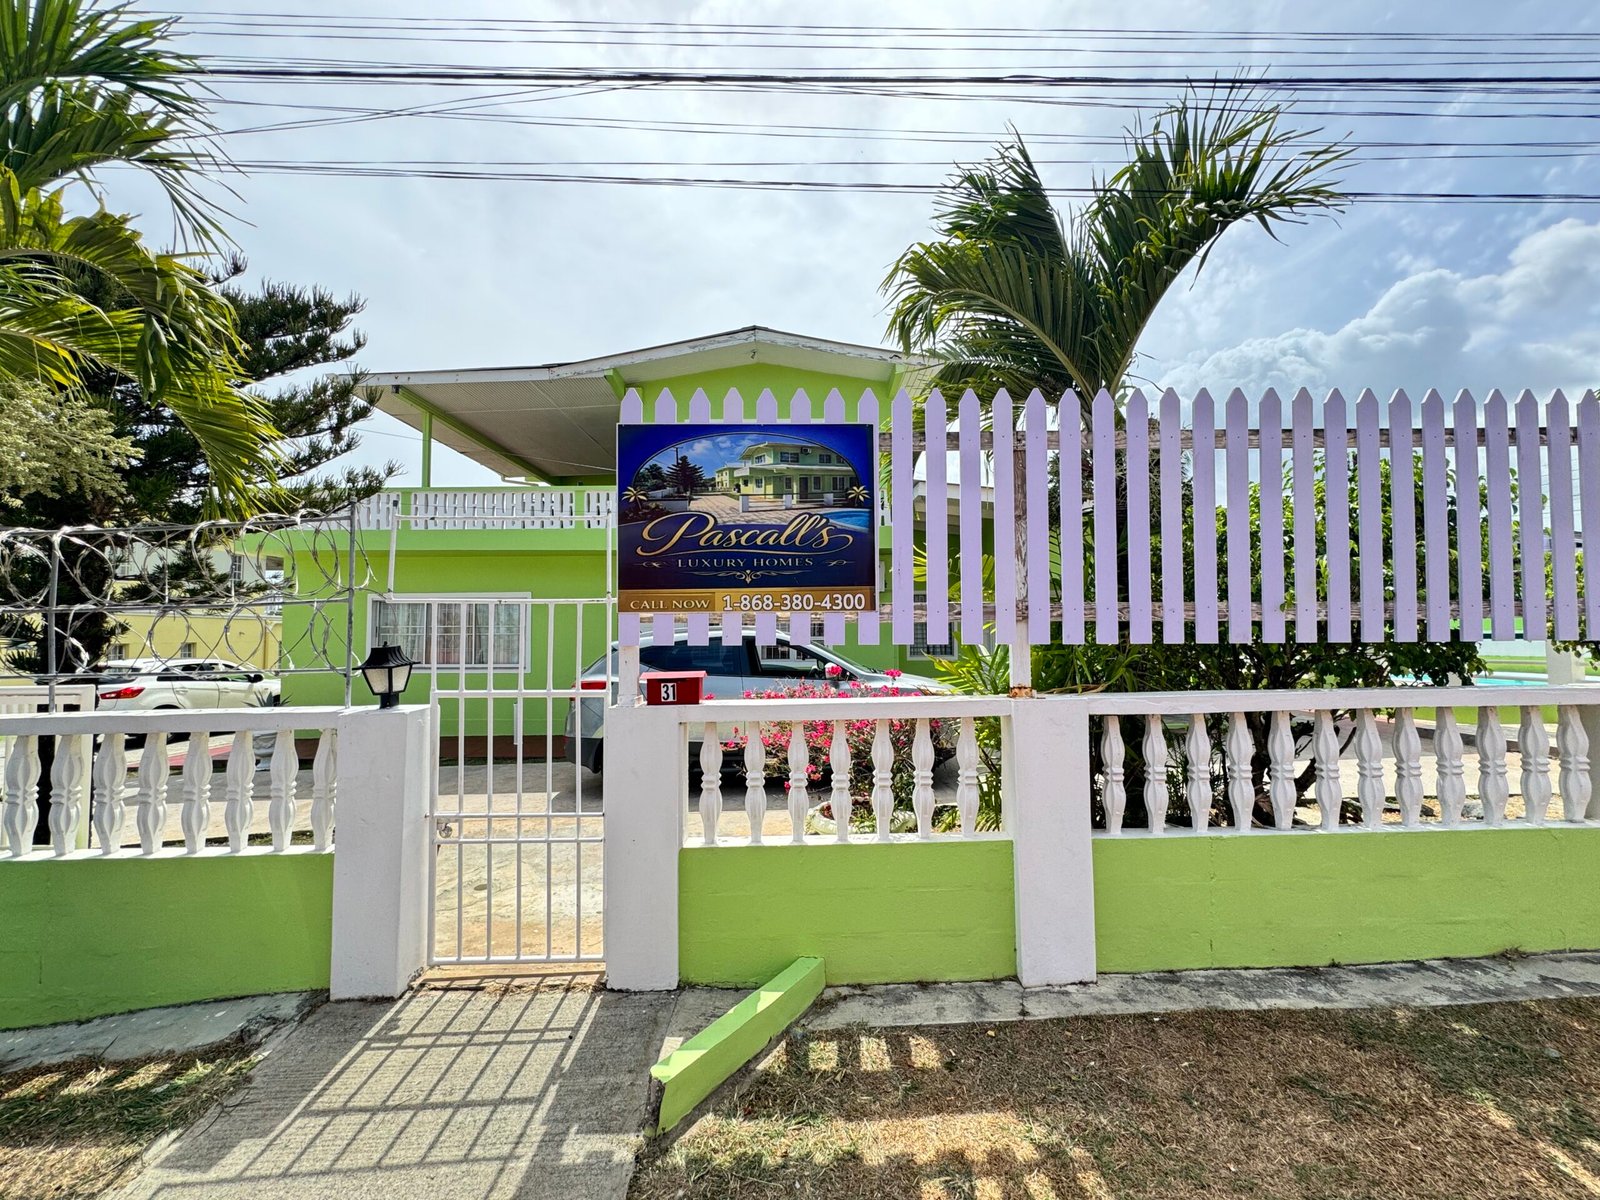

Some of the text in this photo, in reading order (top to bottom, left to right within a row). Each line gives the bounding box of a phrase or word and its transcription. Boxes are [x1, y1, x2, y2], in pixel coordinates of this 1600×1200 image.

[636, 511, 853, 556] Pascall's
[677, 557, 814, 568] LUXURY HOMES
[630, 593, 866, 611] CALL NOW 1-868-380-4300
[661, 684, 677, 702] 31
